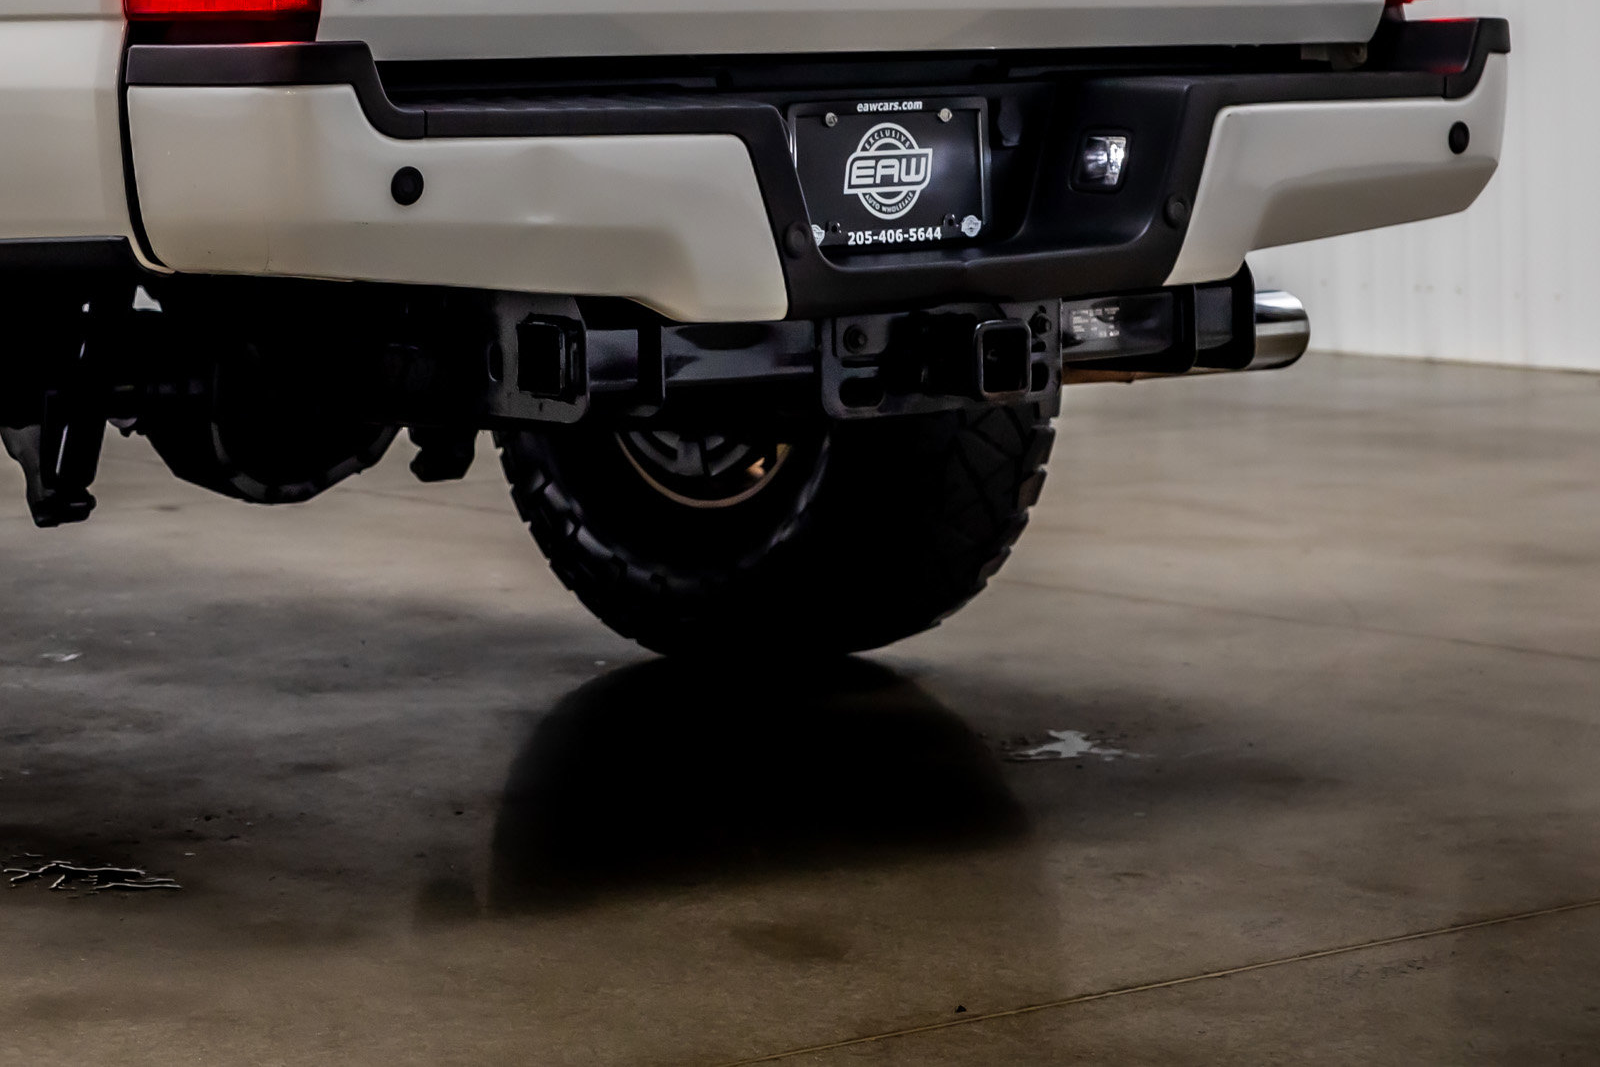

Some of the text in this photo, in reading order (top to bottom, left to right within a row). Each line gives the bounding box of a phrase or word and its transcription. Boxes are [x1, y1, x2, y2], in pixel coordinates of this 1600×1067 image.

[856, 100, 923, 113] eawcars.com
[864, 129, 911, 150] EXCLUSIVE
[850, 157, 927, 186] EAW
[864, 193, 881, 210] AUTO
[847, 227, 942, 246] 205-406-5644
